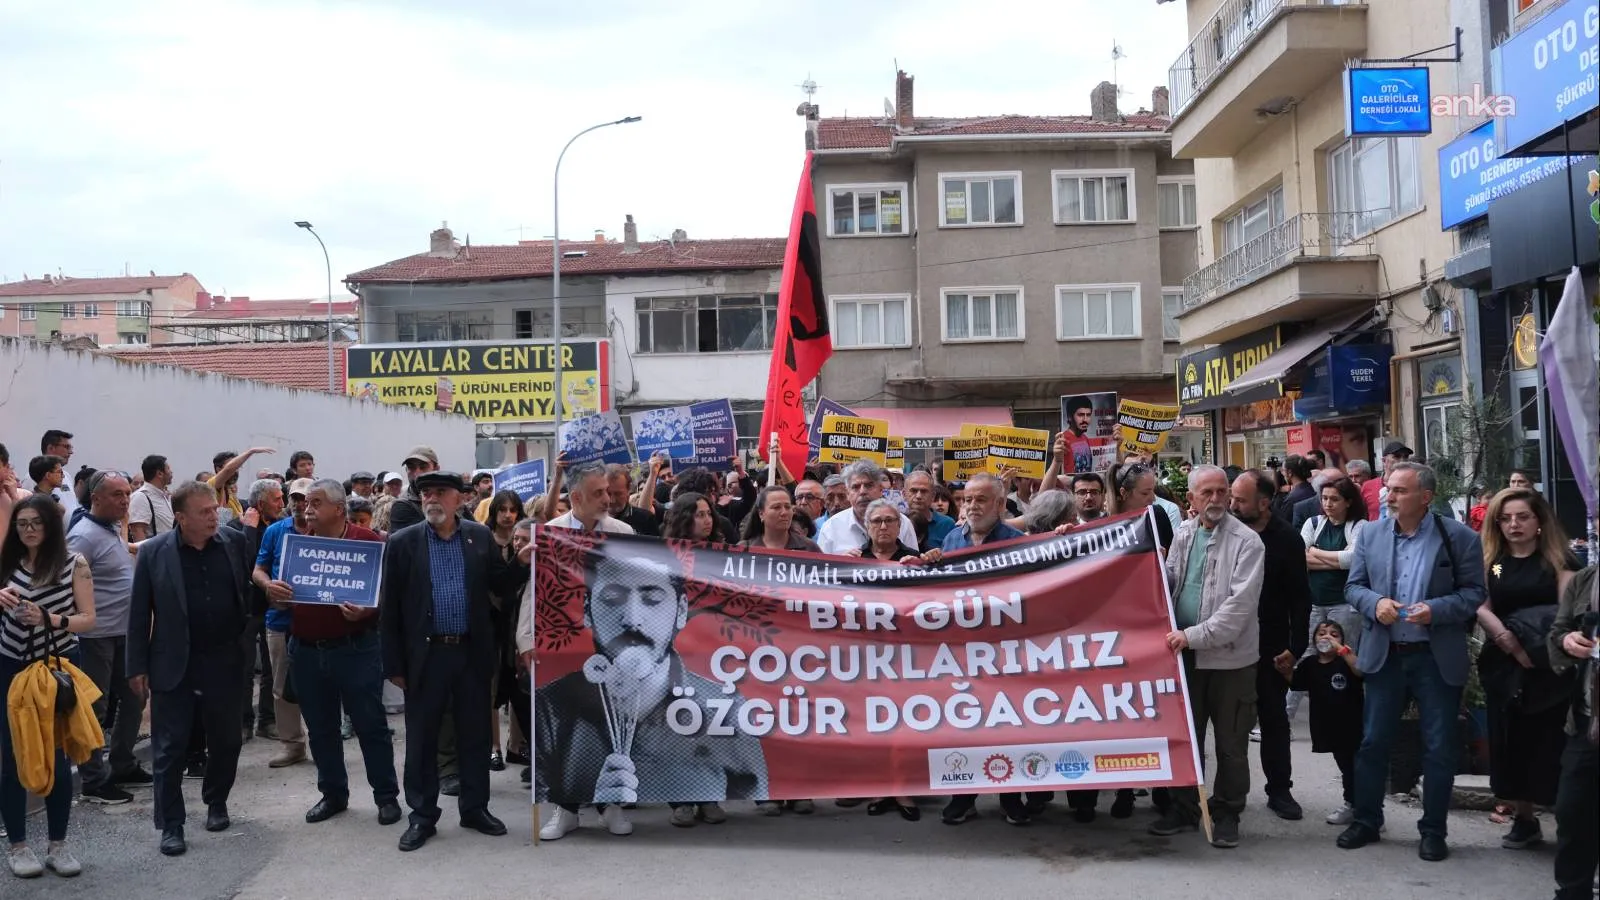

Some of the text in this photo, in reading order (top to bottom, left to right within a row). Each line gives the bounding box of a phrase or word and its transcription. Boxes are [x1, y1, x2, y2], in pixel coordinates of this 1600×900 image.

[1534, 19, 1577, 71] OTO
[1381, 84, 1399, 93] OTO
[1361, 93, 1419, 104] GALERİCİLER
[1360, 105, 1421, 114] DERNEĞİ LOKALİ
[1450, 138, 1496, 179] OTO G
[371, 345, 574, 374] KAYALAR CENTER
[1204, 357, 1230, 398] ATA
[1350, 368, 1374, 376] SUDEM
[382, 381, 456, 397] KIRTASİE
[835, 421, 855, 434] GENEL
[857, 424, 875, 436] GREV
[828, 434, 848, 448] GENEL
[915, 440, 933, 449] ÇAY
[695, 446, 717, 454] İDER
[298, 548, 368, 563] KARANLIK
[723, 555, 756, 580] ALİ
[767, 557, 842, 585] İSMAİL
[965, 523, 1140, 574] ONURUMUZDUR!
[310, 560, 351, 575] GİDER
[292, 574, 366, 590] GEZİ KALIR
[785, 588, 1024, 631] "BİR GÜN
[710, 630, 1124, 694] ÇOCUKLARIMIZ
[666, 678, 1176, 736] ÖZGÜR DOĞACAK!"
[1055, 762, 1090, 773] KESK
[1095, 753, 1158, 769] tmmob
[941, 771, 975, 782] ALİKEV
